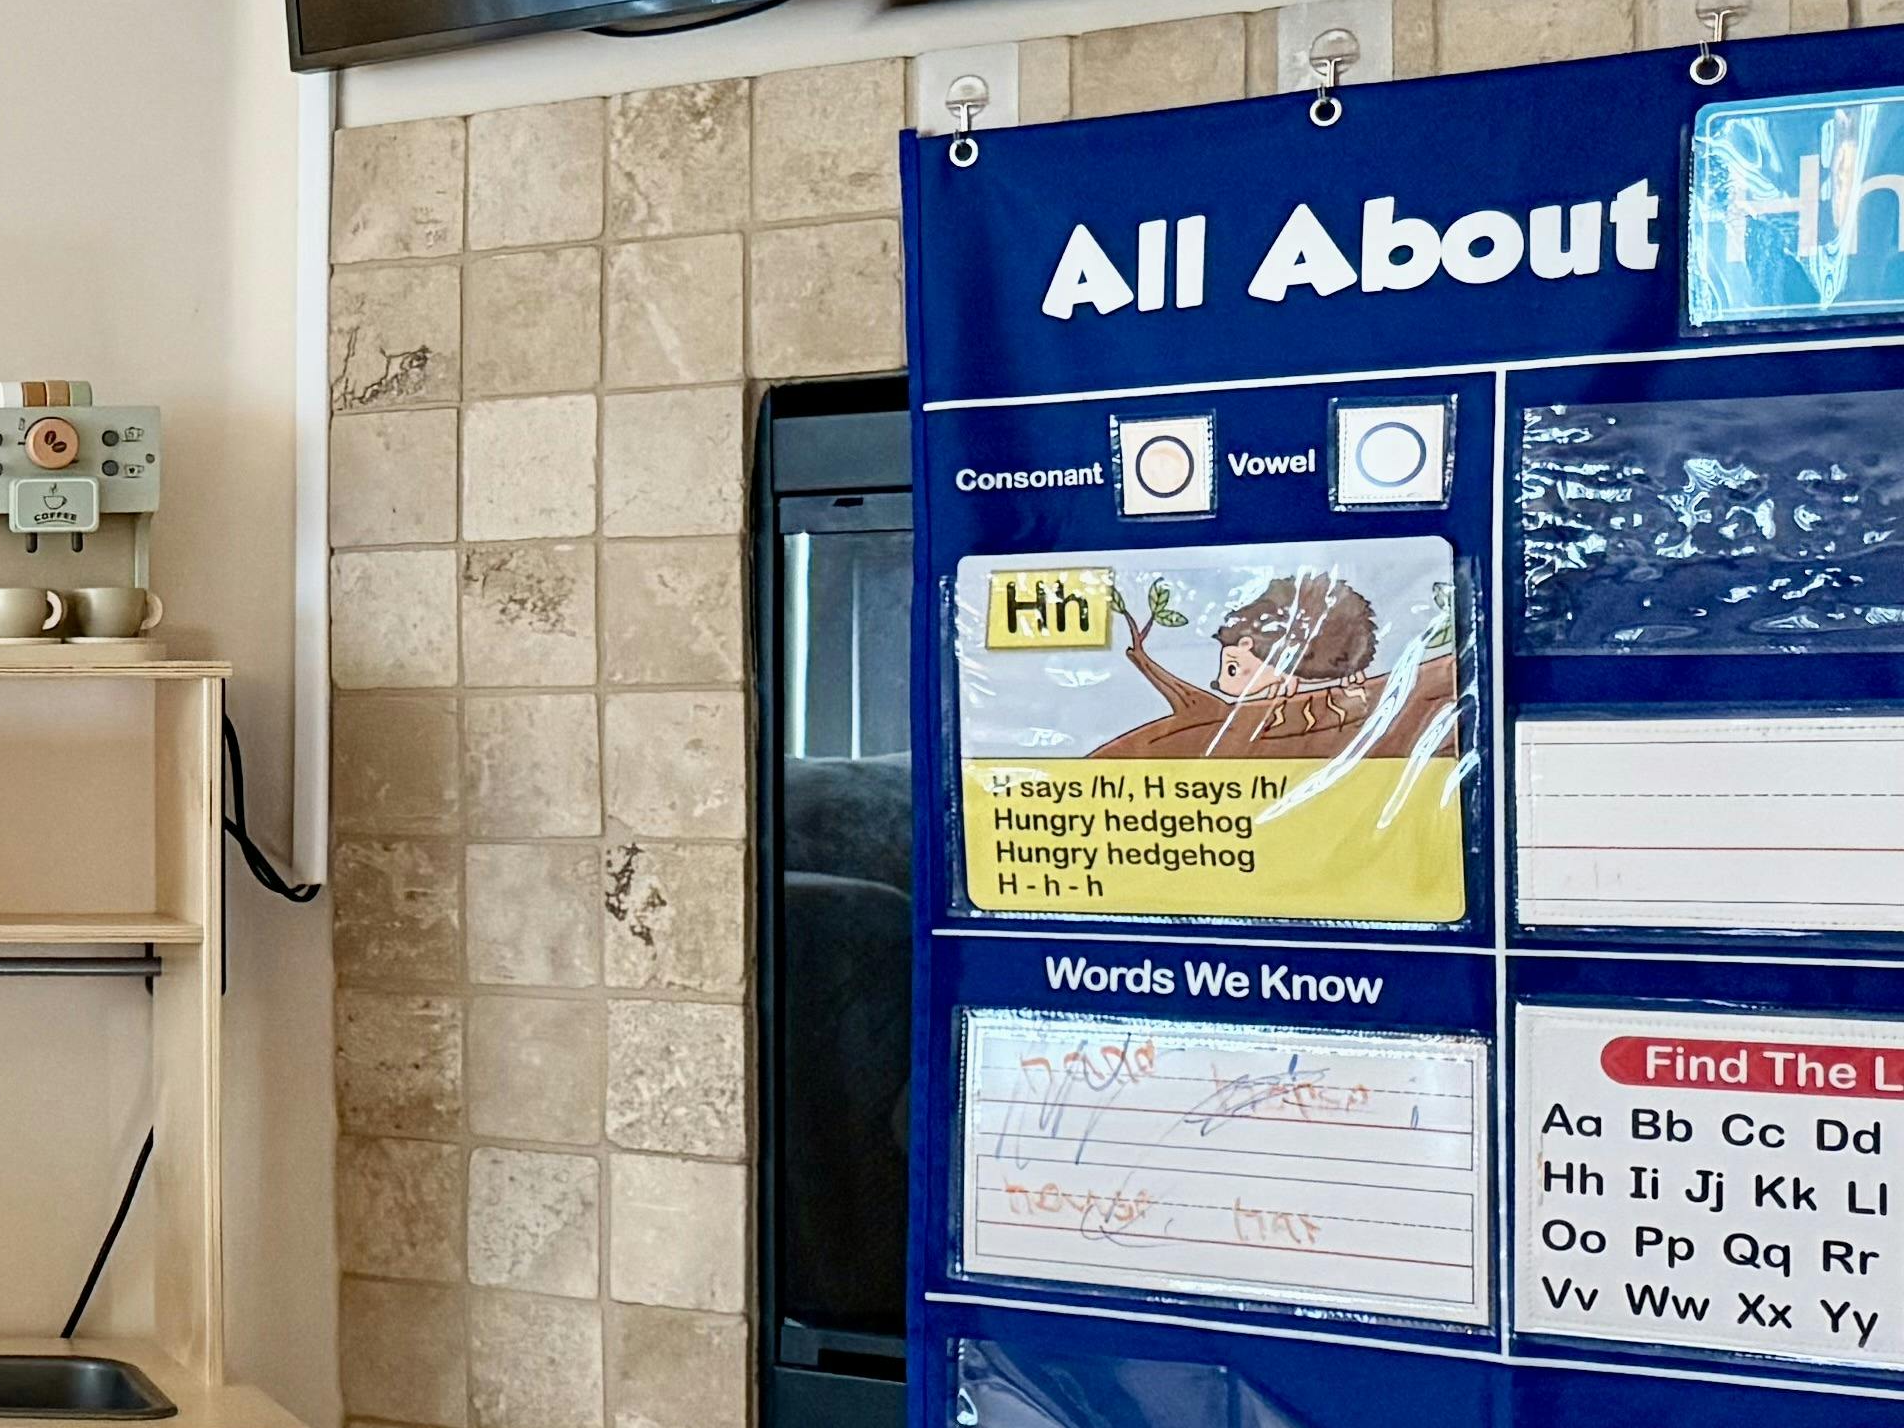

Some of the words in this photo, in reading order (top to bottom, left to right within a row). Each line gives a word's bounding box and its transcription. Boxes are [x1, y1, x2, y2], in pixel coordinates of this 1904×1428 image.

[1726, 139, 1904, 263] Hh
[1042, 215, 1205, 320] All
[1248, 178, 1659, 301] About
[956, 462, 1103, 492] Consonant
[1228, 449, 1315, 478] Vowel
[33, 511, 78, 523] COFFEE
[1006, 579, 1089, 634] Hh
[1020, 780, 1083, 804] says
[1144, 775, 1165, 798] H
[1174, 780, 1242, 805] says
[994, 807, 1095, 836] Hungry
[1104, 809, 1253, 839] hedgehog
[996, 840, 1098, 870] Hungry
[1107, 843, 1255, 873] hedgehog
[998, 873, 1017, 895] H
[1044, 874, 1060, 896] h
[1087, 875, 1103, 897] h
[1046, 956, 1175, 995] Words
[1184, 960, 1250, 997] We
[1261, 964, 1383, 1004] Know
[1645, 1044, 1748, 1085] Find
[1762, 1050, 1857, 1089] The
[1542, 1103, 1602, 1137] Aa
[1631, 1108, 1693, 1142] Bb
[1721, 1113, 1785, 1148] Cc
[1816, 1118, 1881, 1155] Dd
[1543, 1160, 1604, 1196] Hh
[1629, 1165, 1660, 1200] Ii
[1684, 1169, 1724, 1213] Jj
[1754, 1173, 1818, 1211] Kk
[1847, 1180, 1888, 1216] Ll
[1542, 1219, 1607, 1254] Oo
[1635, 1226, 1695, 1269] Pp
[1722, 1232, 1791, 1278] Qq
[1822, 1239, 1880, 1275] Rr
[1541, 1276, 1599, 1312] Vv
[1624, 1282, 1710, 1321] Ww
[1737, 1292, 1793, 1329] Xx
[1820, 1298, 1879, 1348] Yy
